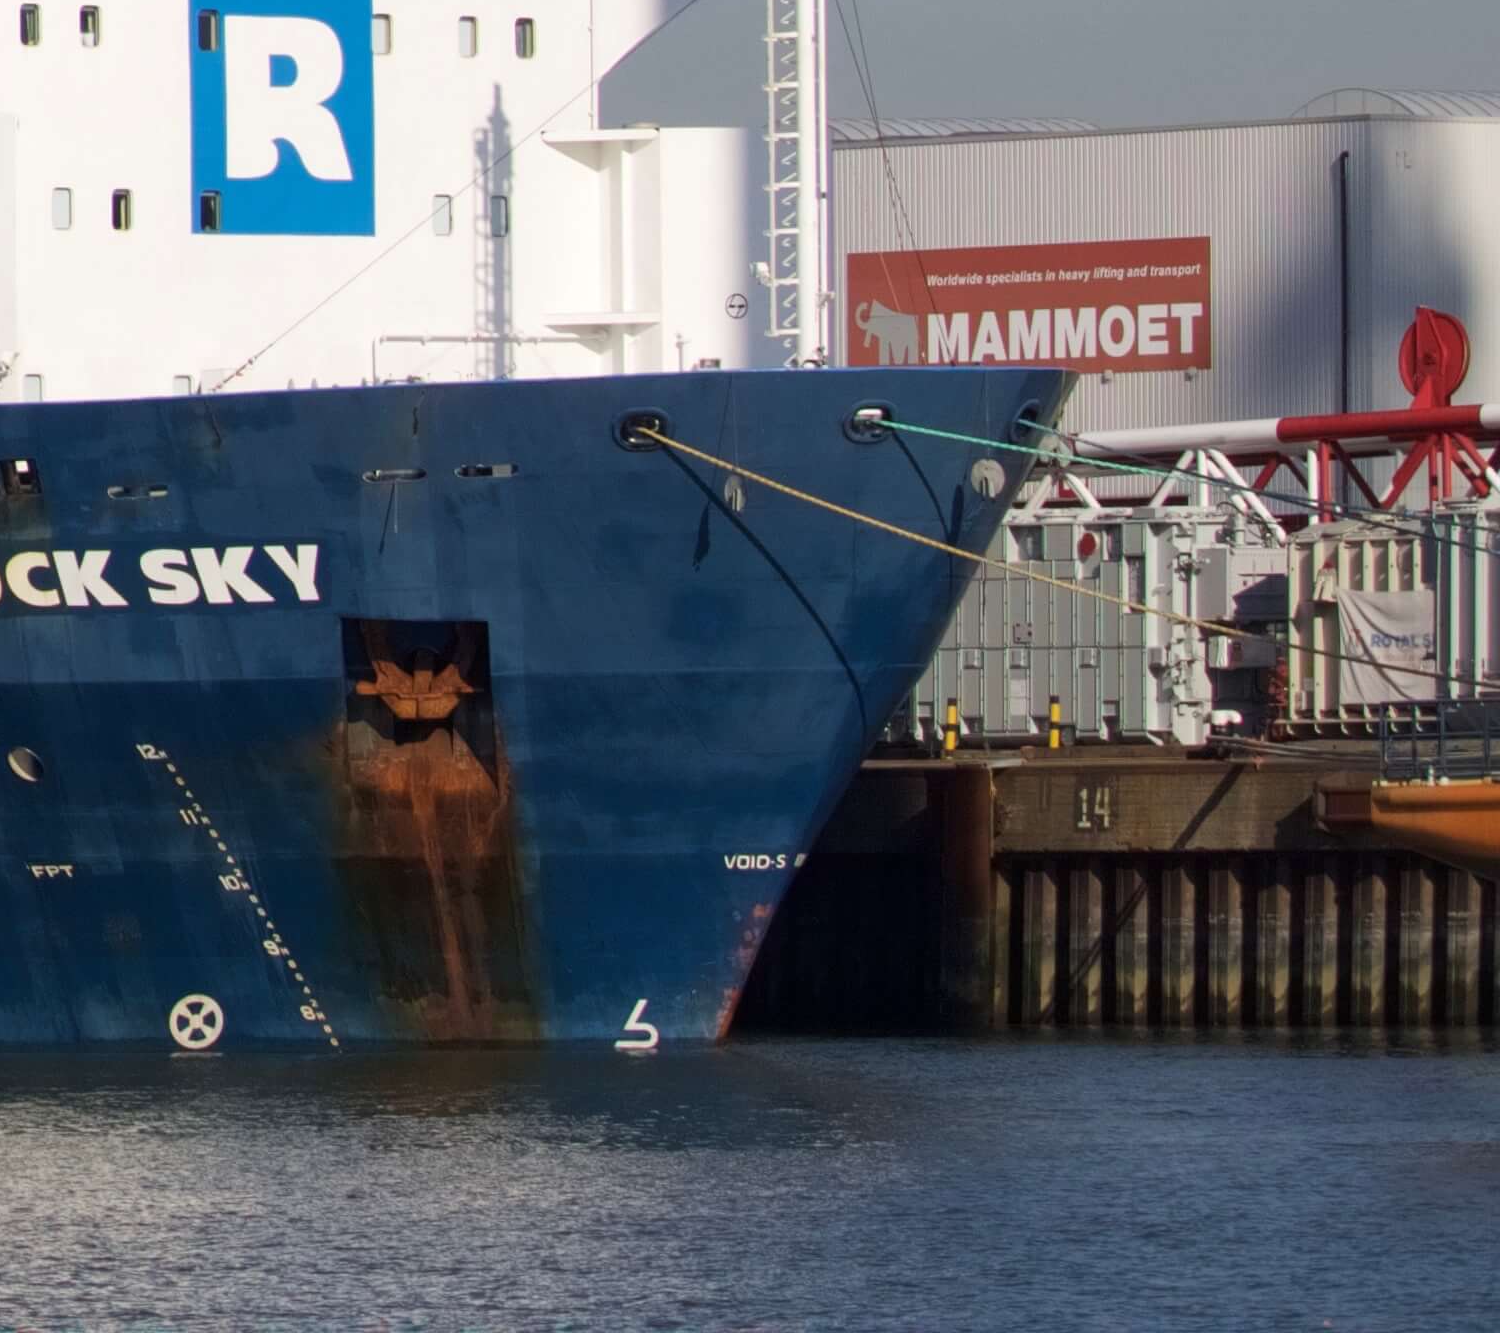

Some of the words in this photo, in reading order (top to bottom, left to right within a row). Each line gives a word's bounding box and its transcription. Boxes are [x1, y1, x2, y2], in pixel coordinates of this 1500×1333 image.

[224, 15, 353, 181] R
[927, 273, 983, 286] Worldwide
[986, 270, 1043, 285] specialists
[1045, 269, 1056, 282] in
[1058, 268, 1090, 283] heavy
[1093, 266, 1124, 282] lifting
[1127, 266, 1147, 278] and
[1149, 263, 1201, 278] transport
[927, 303, 1203, 364] MAMMOET
[139, 544, 321, 606] SKY
[1371, 633, 1419, 647] ROYAL
[1076, 787, 1110, 829] 14
[31, 865, 73, 877] FPT
